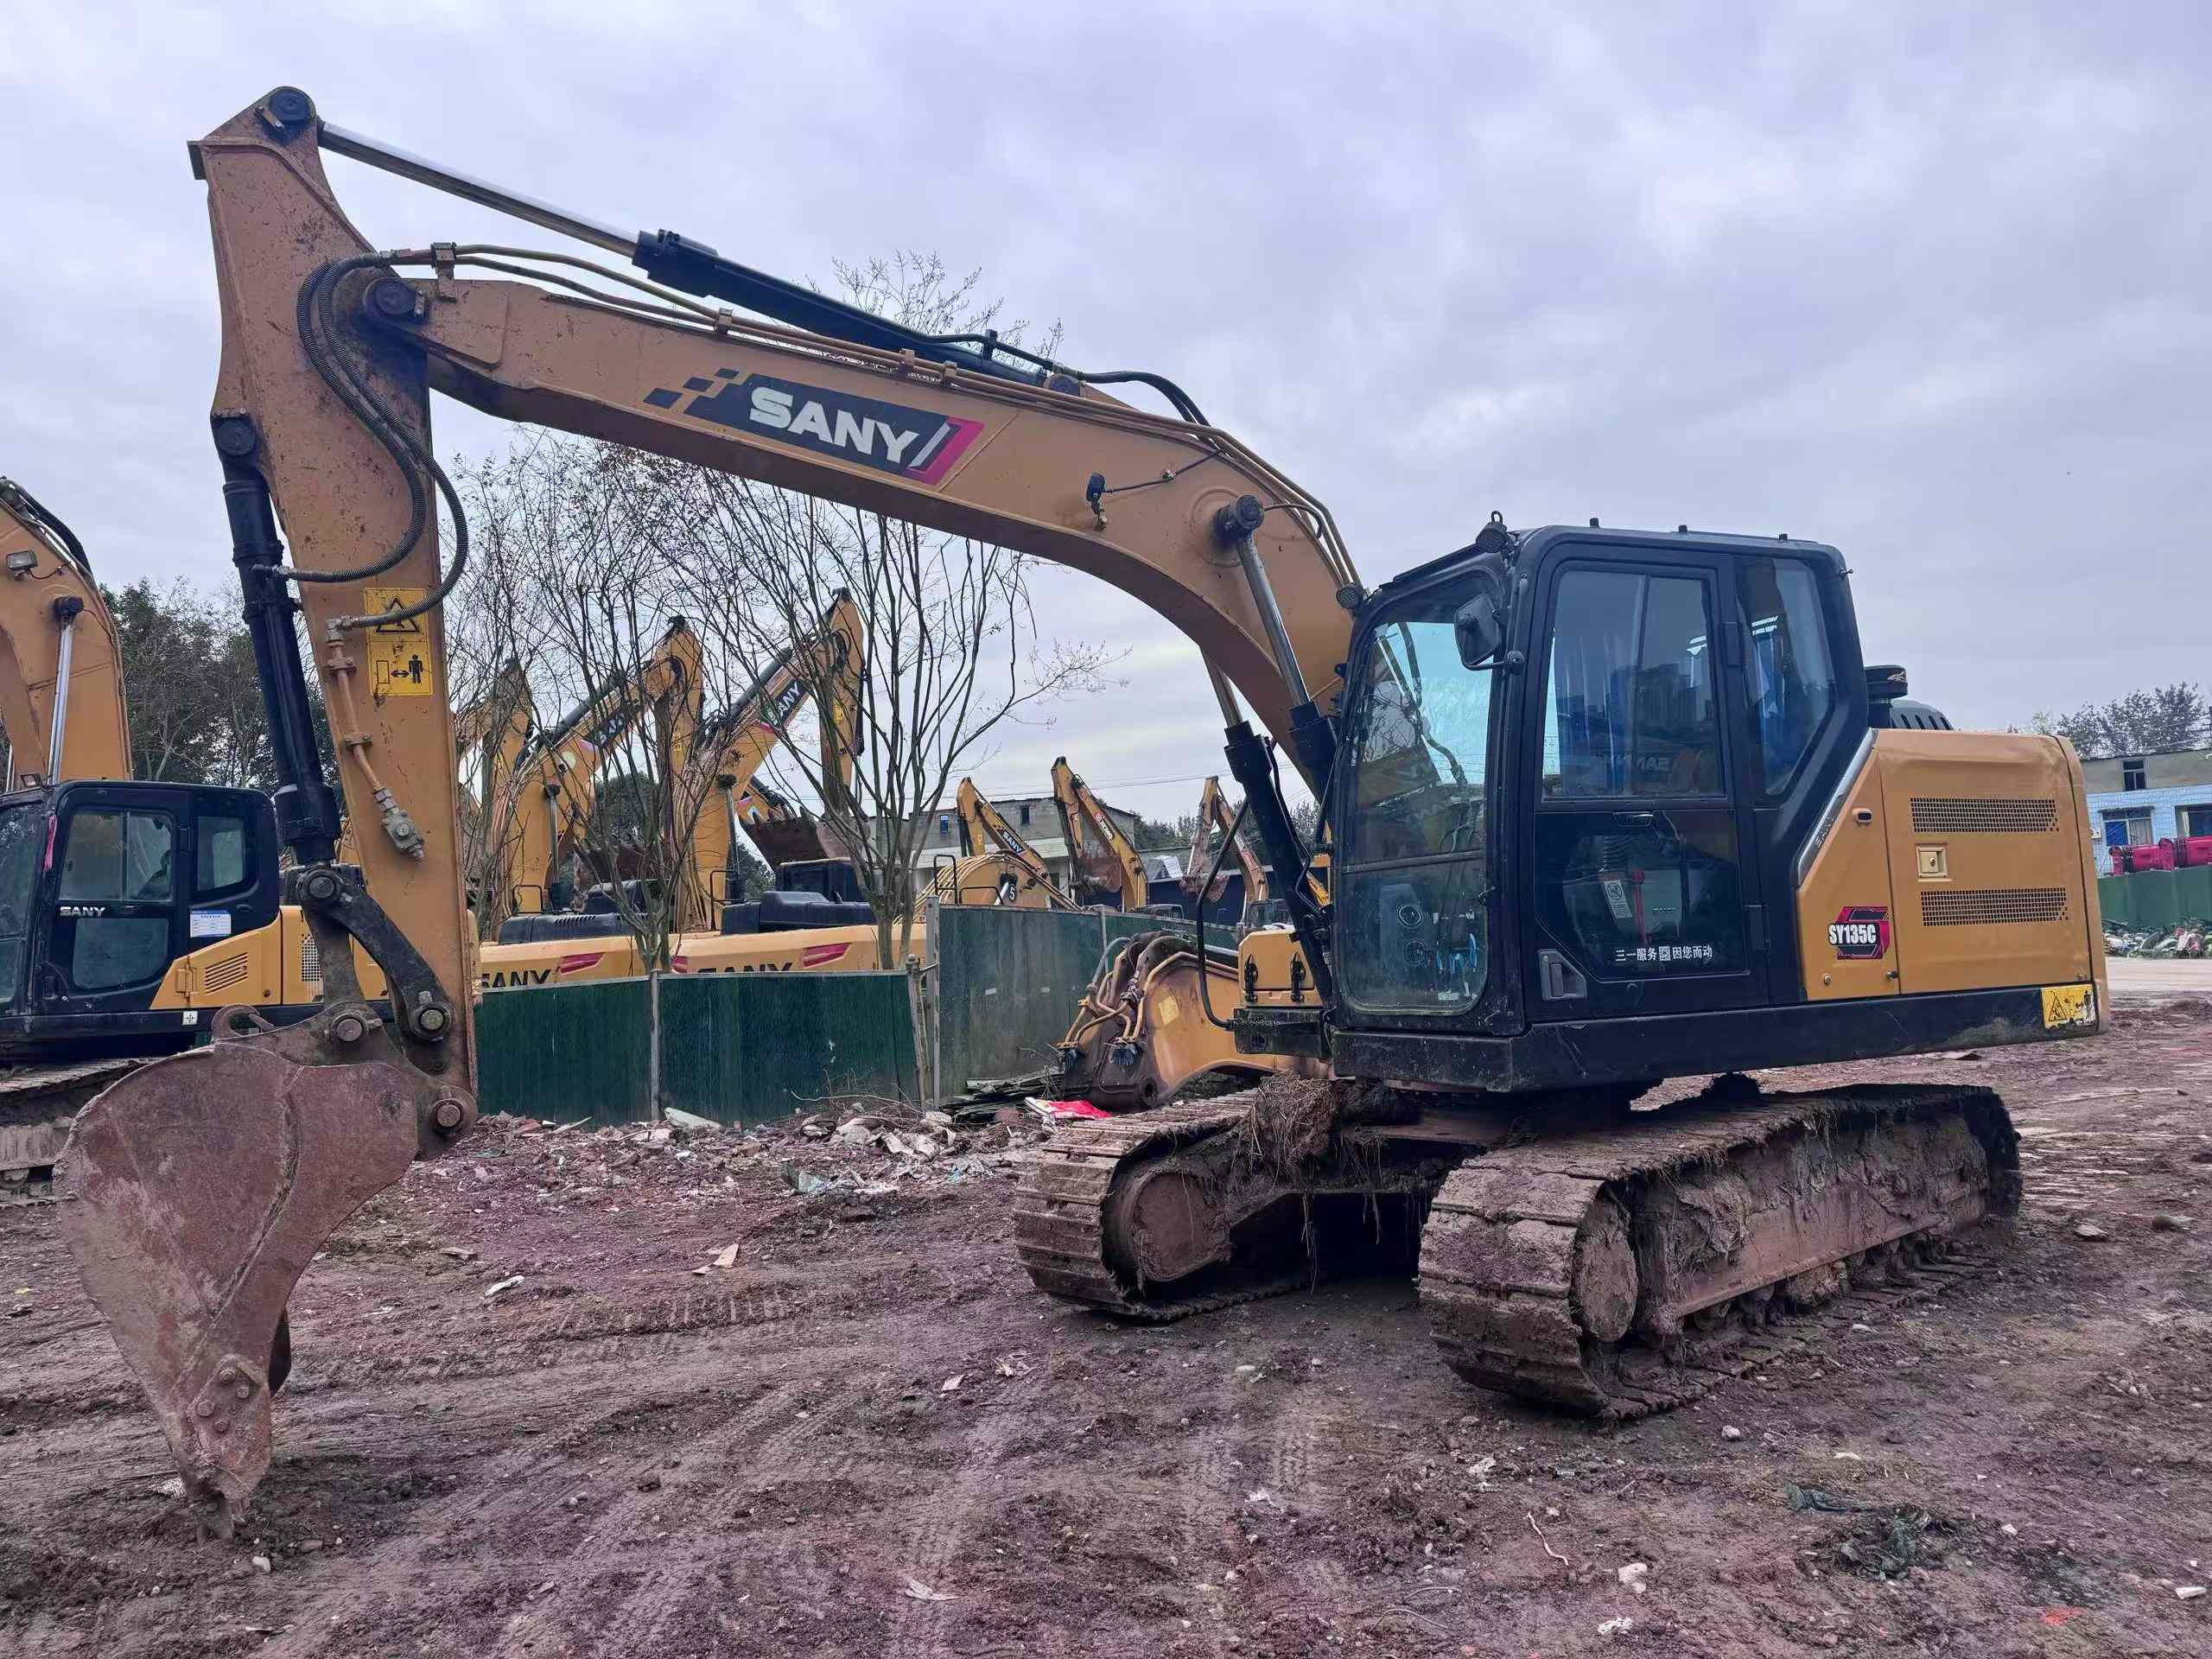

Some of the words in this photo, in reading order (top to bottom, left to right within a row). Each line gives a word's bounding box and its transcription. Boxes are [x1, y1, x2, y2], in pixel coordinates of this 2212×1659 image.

[748, 386, 919, 464] SANY
[1002, 830, 1023, 853] SANY
[60, 906, 105, 918] SANY
[1828, 924, 1877, 944] SY135C
[1615, 947, 1657, 962] 三一服务
[1672, 944, 1713, 960] 因您而动
